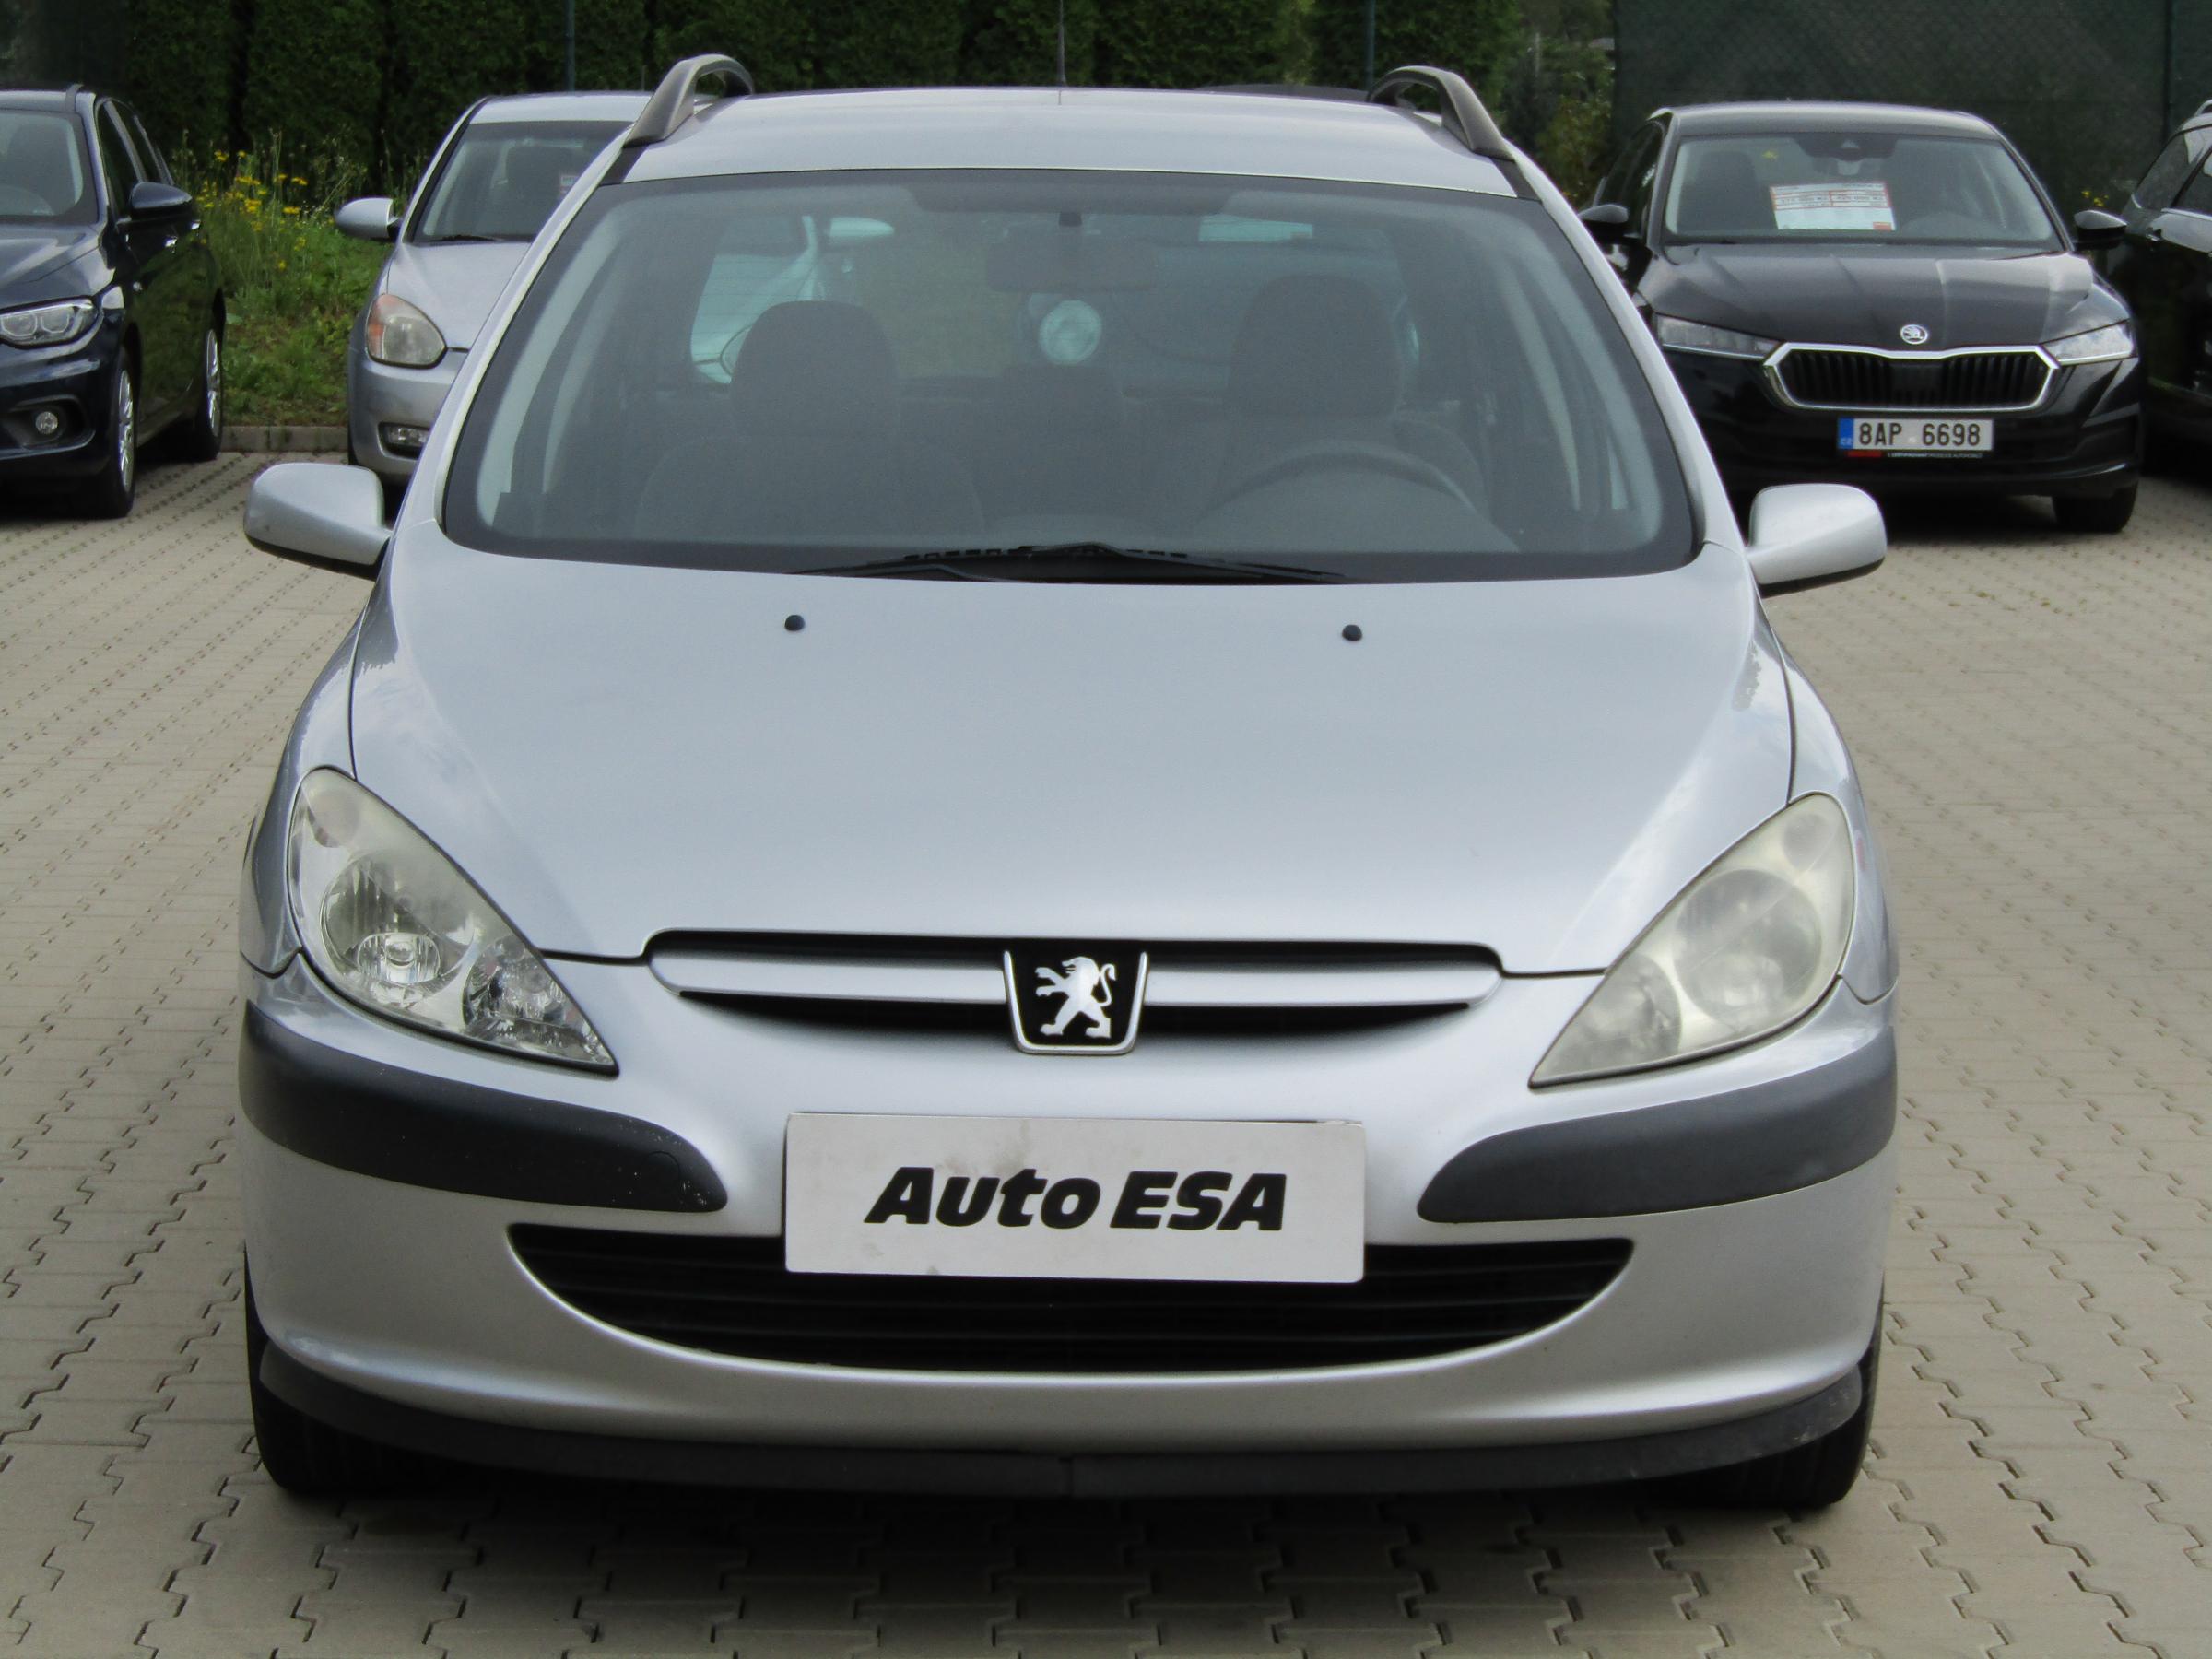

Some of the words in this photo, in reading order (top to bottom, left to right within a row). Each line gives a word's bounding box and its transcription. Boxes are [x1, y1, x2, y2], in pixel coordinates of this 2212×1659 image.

[1858, 422, 1903, 446] 8AP
[1922, 423, 1982, 447] 6698
[864, 1166, 1101, 1230] Auto
[1110, 1170, 1288, 1232] ESA
